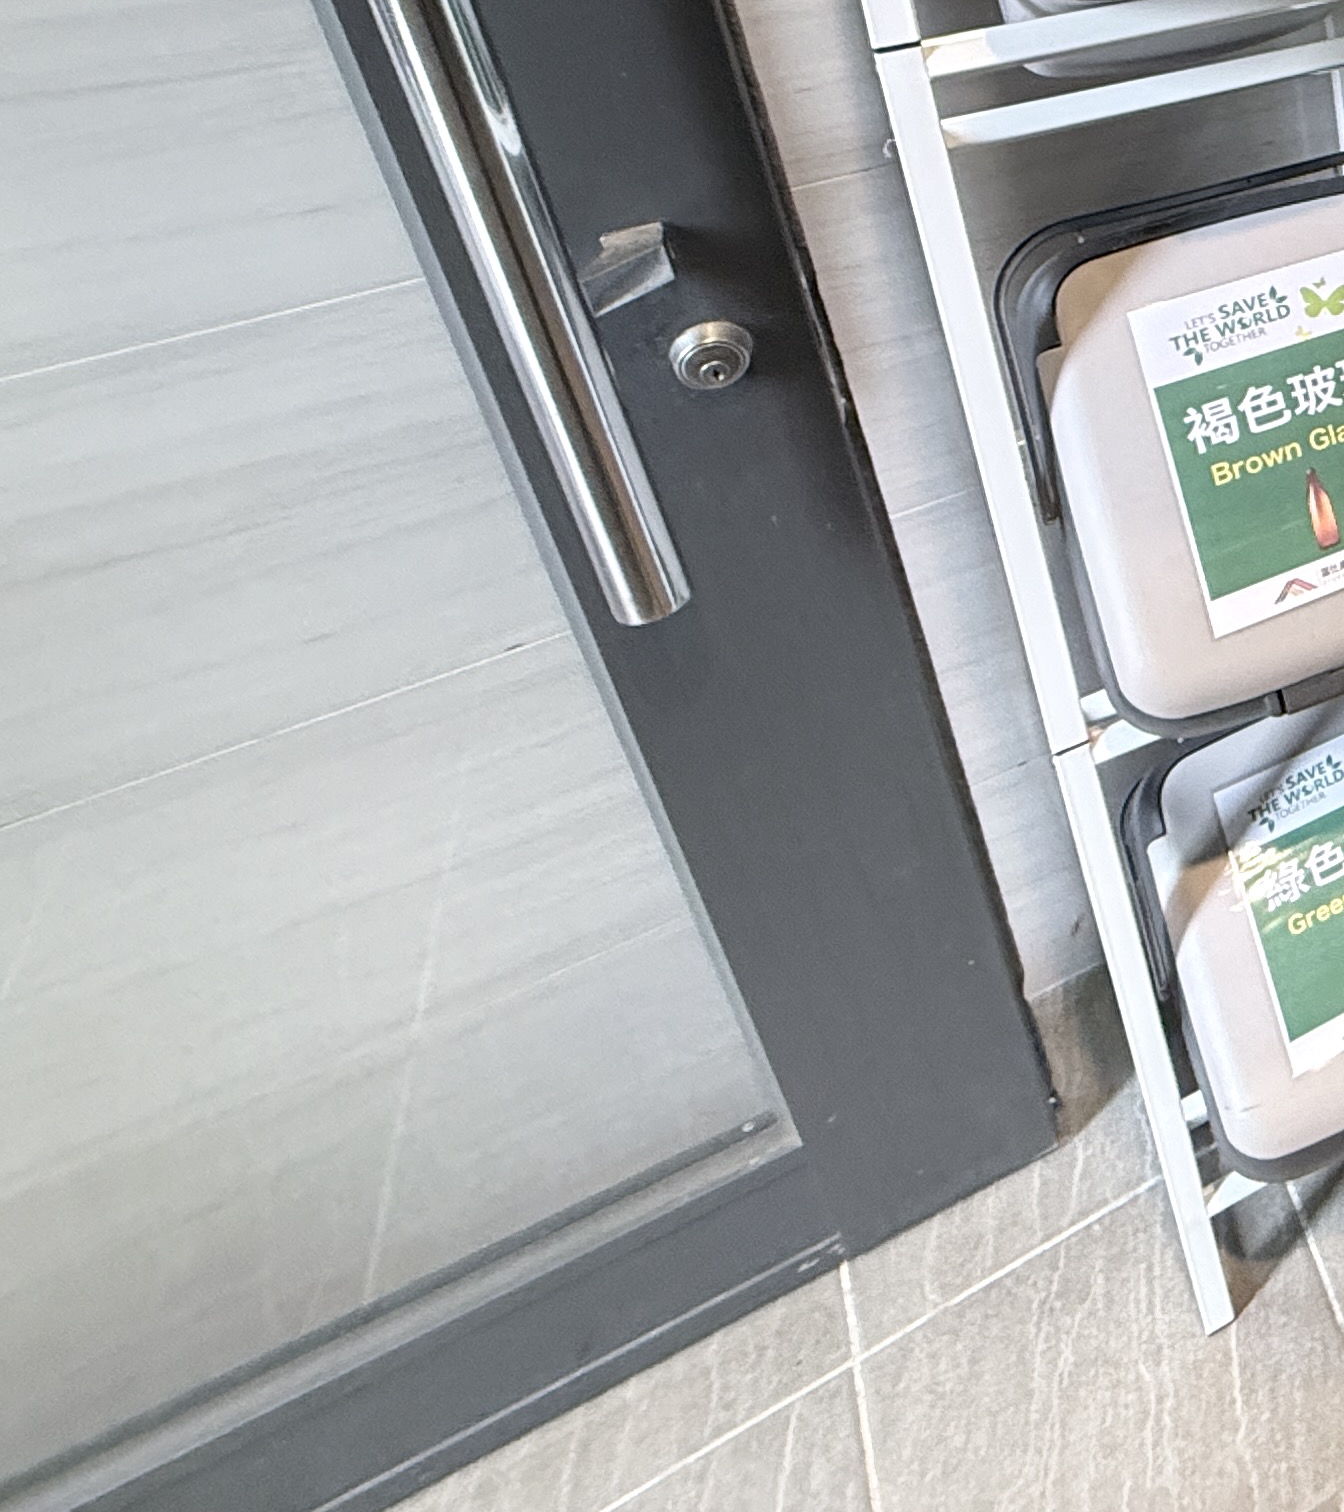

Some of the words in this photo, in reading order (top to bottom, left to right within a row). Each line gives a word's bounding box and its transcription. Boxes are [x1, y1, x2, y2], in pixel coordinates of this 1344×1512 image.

[1216, 291, 1270, 320] SAVE
[1169, 328, 1212, 355] THE
[1215, 302, 1292, 338] WORLD
[1203, 326, 1268, 355] TOGETHER
[1209, 440, 1303, 488] Brown
[1285, 760, 1327, 790] SAVE
[1247, 797, 1282, 822] THE
